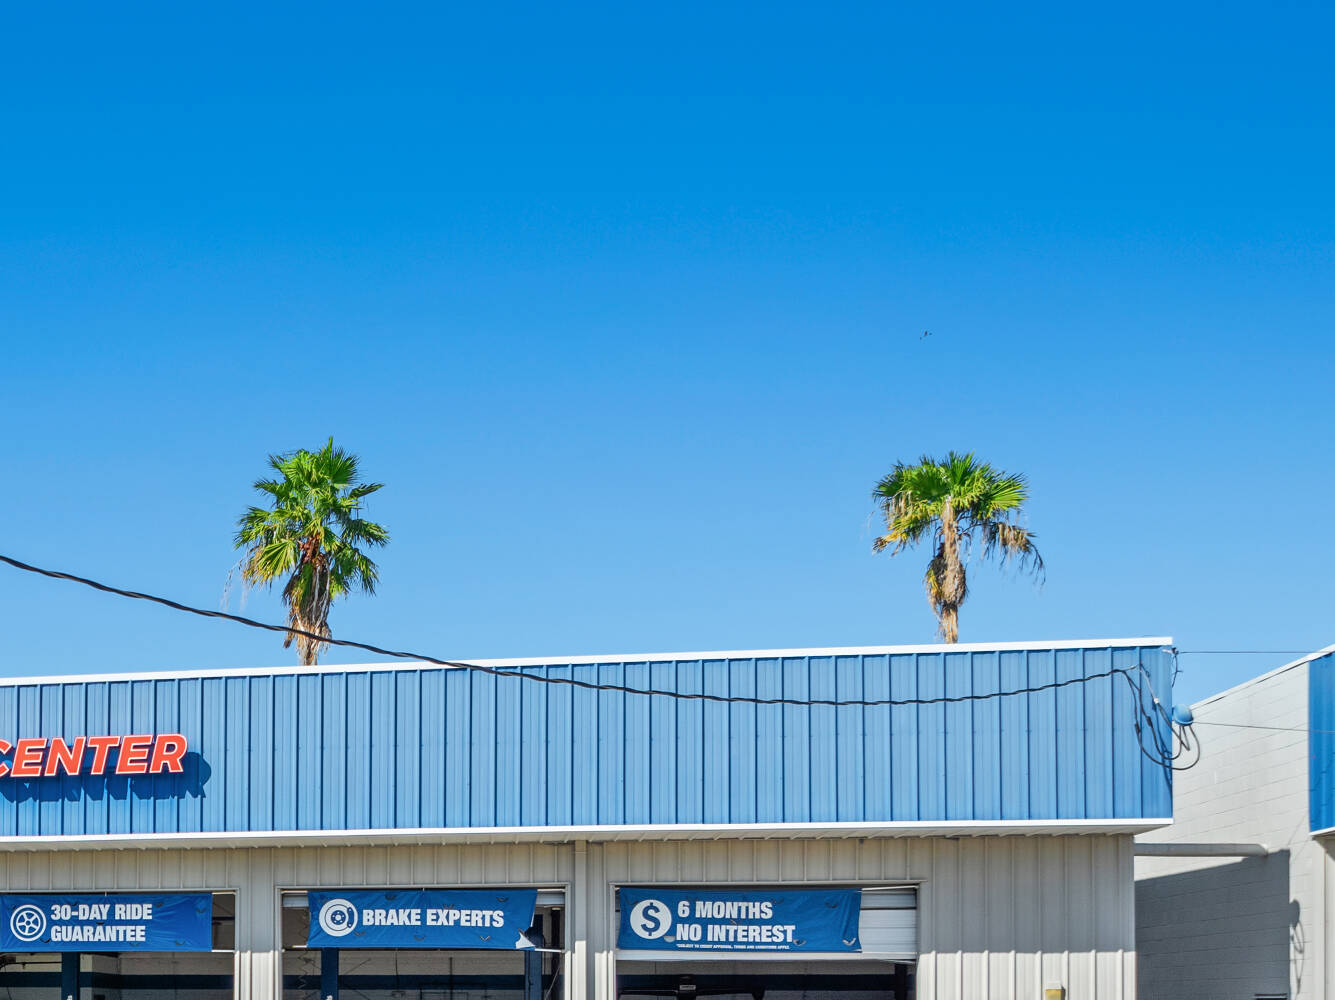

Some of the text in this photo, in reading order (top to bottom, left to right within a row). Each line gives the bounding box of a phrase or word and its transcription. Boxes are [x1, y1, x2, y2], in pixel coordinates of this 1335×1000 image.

[51, 903, 153, 920] 30-DAY RIDE
[362, 908, 504, 928] BRAKE EXPERTS
[678, 901, 773, 919] 6 MONTHS
[51, 925, 146, 942] GUARANTEE
[676, 924, 796, 943] NO INTEREST
